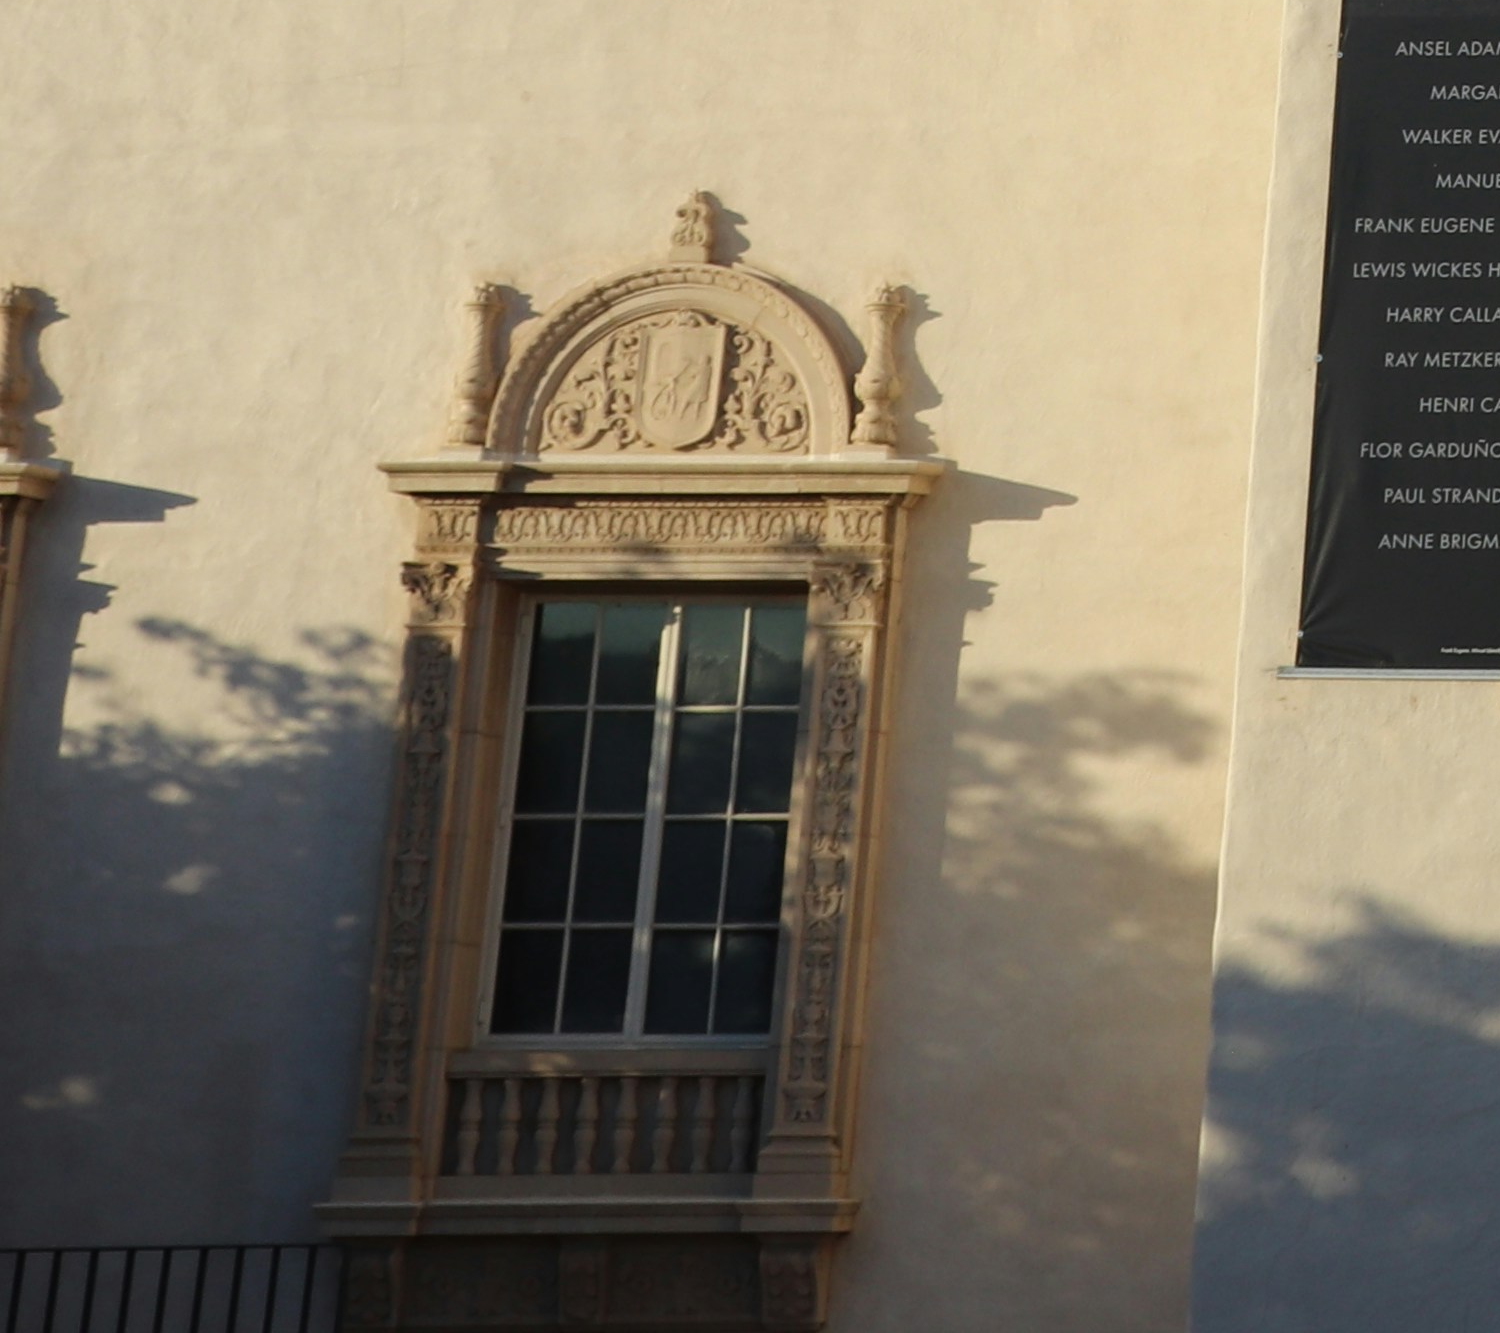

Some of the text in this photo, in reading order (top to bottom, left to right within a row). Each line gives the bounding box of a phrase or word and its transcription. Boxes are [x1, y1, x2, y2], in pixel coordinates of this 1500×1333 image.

[1395, 41, 1451, 56] ANSEL
[1402, 129, 1472, 144] WALKER
[1355, 218, 1414, 233] FRANK
[1421, 218, 1494, 233] EUGENE
[1353, 263, 1405, 278] LEWIS
[1412, 262, 1481, 278] WICKES
[1386, 308, 1444, 323] HARRY
[1384, 353, 1418, 368] RAY
[1419, 398, 1474, 413] HENRI
[1360, 443, 1402, 458] FLOR
[1384, 488, 1426, 503] PAUL
[1378, 534, 1434, 549] ANNE
